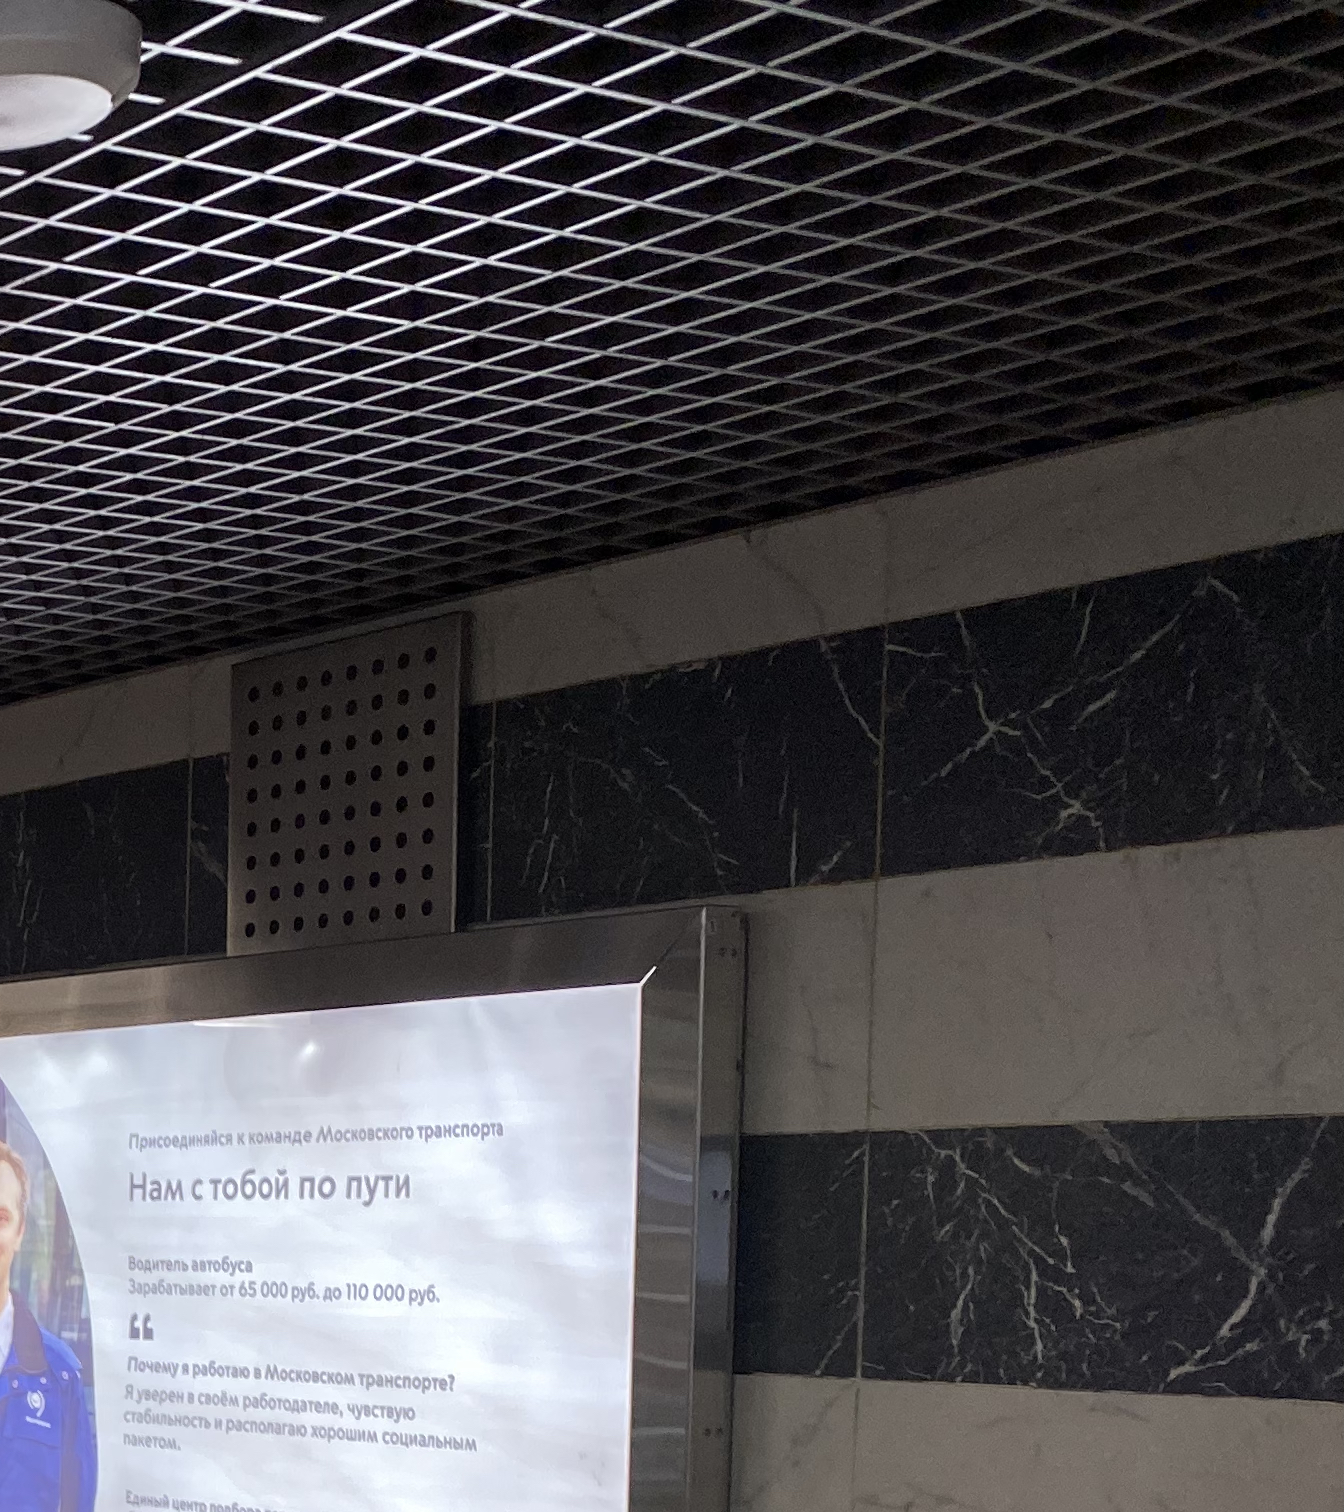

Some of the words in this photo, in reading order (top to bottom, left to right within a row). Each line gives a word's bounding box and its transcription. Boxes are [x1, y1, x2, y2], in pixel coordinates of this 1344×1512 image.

[128, 1130, 233, 1152] Присоединяйся
[237, 1132, 246, 1146] к
[248, 1130, 312, 1147] команде
[315, 1125, 414, 1143] Московского
[417, 1122, 504, 1143] транспорта
[128, 1171, 185, 1202] Нам
[190, 1178, 204, 1201] с
[208, 1168, 290, 1201] тобой
[298, 1175, 337, 1201] по
[345, 1173, 411, 1208] пути
[128, 1255, 189, 1274] Водитель
[191, 1255, 253, 1277] автобуса
[128, 1278, 217, 1298] Зарабатывает
[219, 1284, 236, 1298] от
[238, 1280, 258, 1298] 65
[261, 1280, 289, 1300] 000
[291, 1281, 320, 1304] руб.
[322, 1286, 343, 1303] до
[346, 1282, 369, 1302] 110
[373, 1283, 406, 1302] 000
[408, 1284, 441, 1307] руб.
[127, 1355, 179, 1379] Почему
[182, 1362, 190, 1376] я
[192, 1360, 251, 1380] работаю
[253, 1367, 262, 1380] в
[264, 1363, 356, 1387] Московском
[358, 1371, 456, 1395] транспорте?
[124, 1384, 134, 1401] Я
[136, 1387, 185, 1406] уверен
[187, 1391, 195, 1405] в
[197, 1389, 240, 1408] своём
[242, 1392, 344, 1418] работодателе,
[347, 1402, 416, 1424] чувствую
[123, 1407, 211, 1430] стабильность
[214, 1416, 223, 1430] и
[225, 1418, 308, 1438] располагаю
[310, 1424, 379, 1444] хорошим
[382, 1430, 478, 1452] социальным
[123, 1433, 182, 1451] пакетом.
[125, 1489, 170, 1510] Единый
